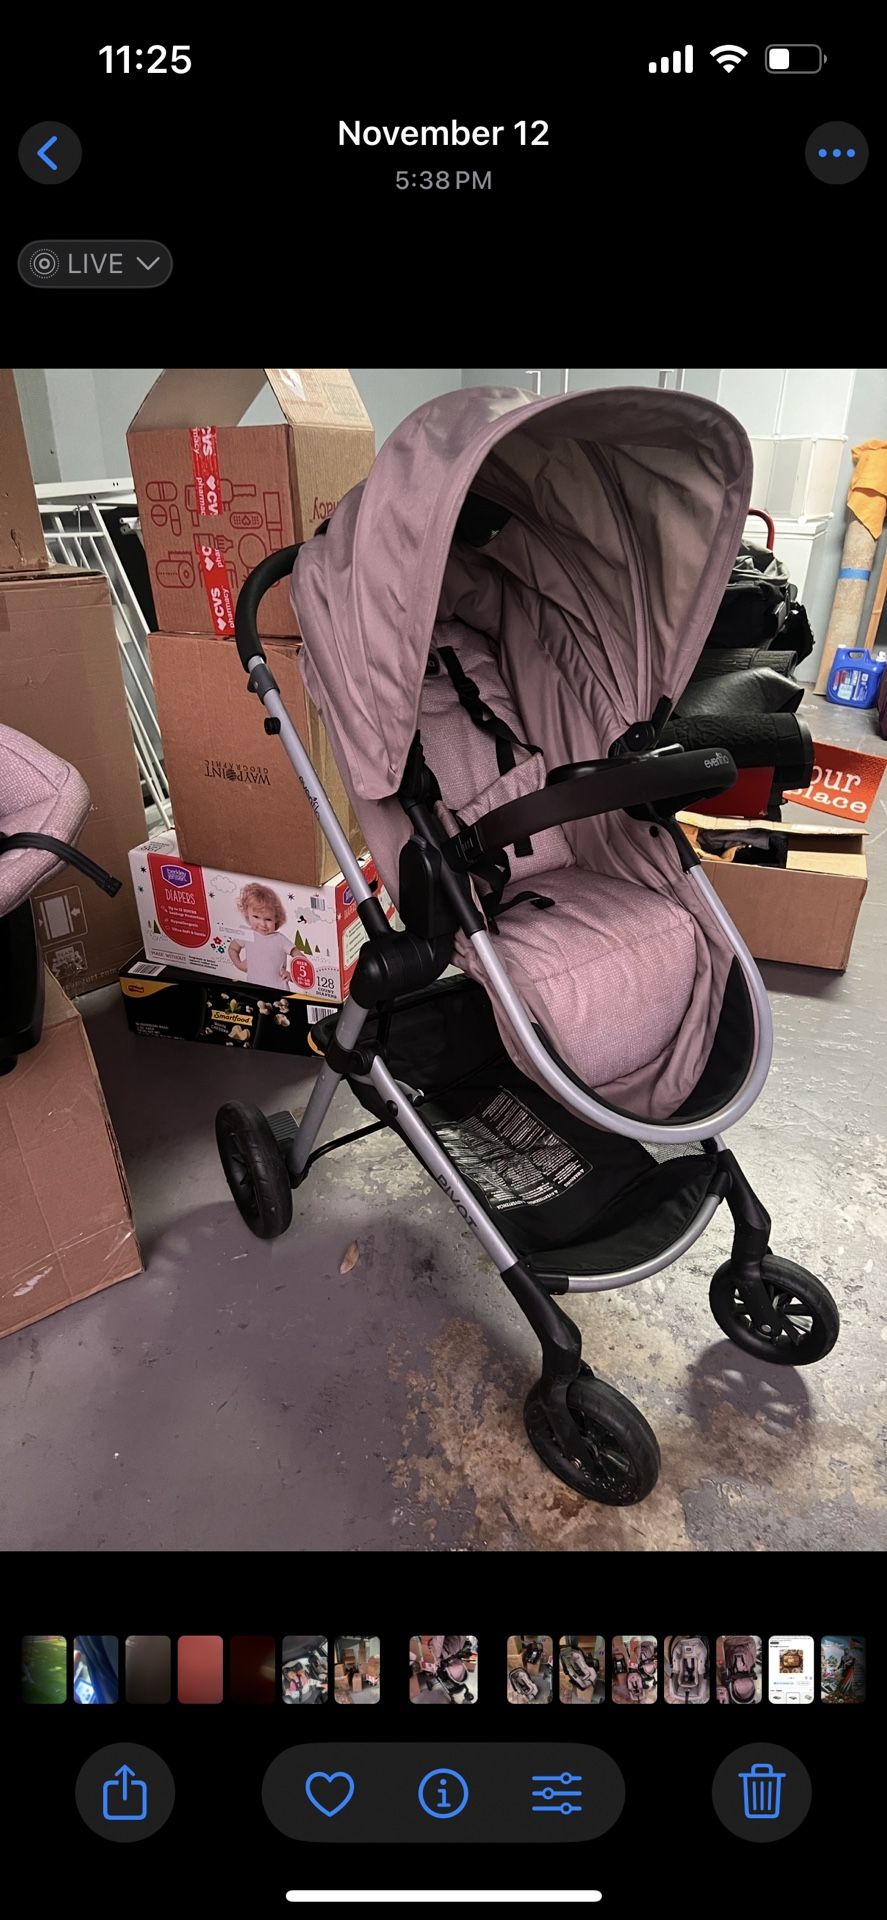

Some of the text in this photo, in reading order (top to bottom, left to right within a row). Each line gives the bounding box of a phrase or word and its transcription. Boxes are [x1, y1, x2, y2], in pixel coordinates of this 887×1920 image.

[99, 45, 191, 74] 11:25
[338, 119, 549, 145] November 12
[395, 171, 492, 190] 5:38 PM
[68, 253, 123, 274] LIVE
[211, 587, 225, 617] CVS
[223, 588, 235, 628] pharmacy
[704, 752, 729, 769] evenflo
[165, 889, 196, 905] DIAPERS
[299, 965, 307, 978] 5
[316, 976, 335, 990] 128
[213, 1011, 250, 1023] Smartfood
[437, 1174, 479, 1230] PIVOT
